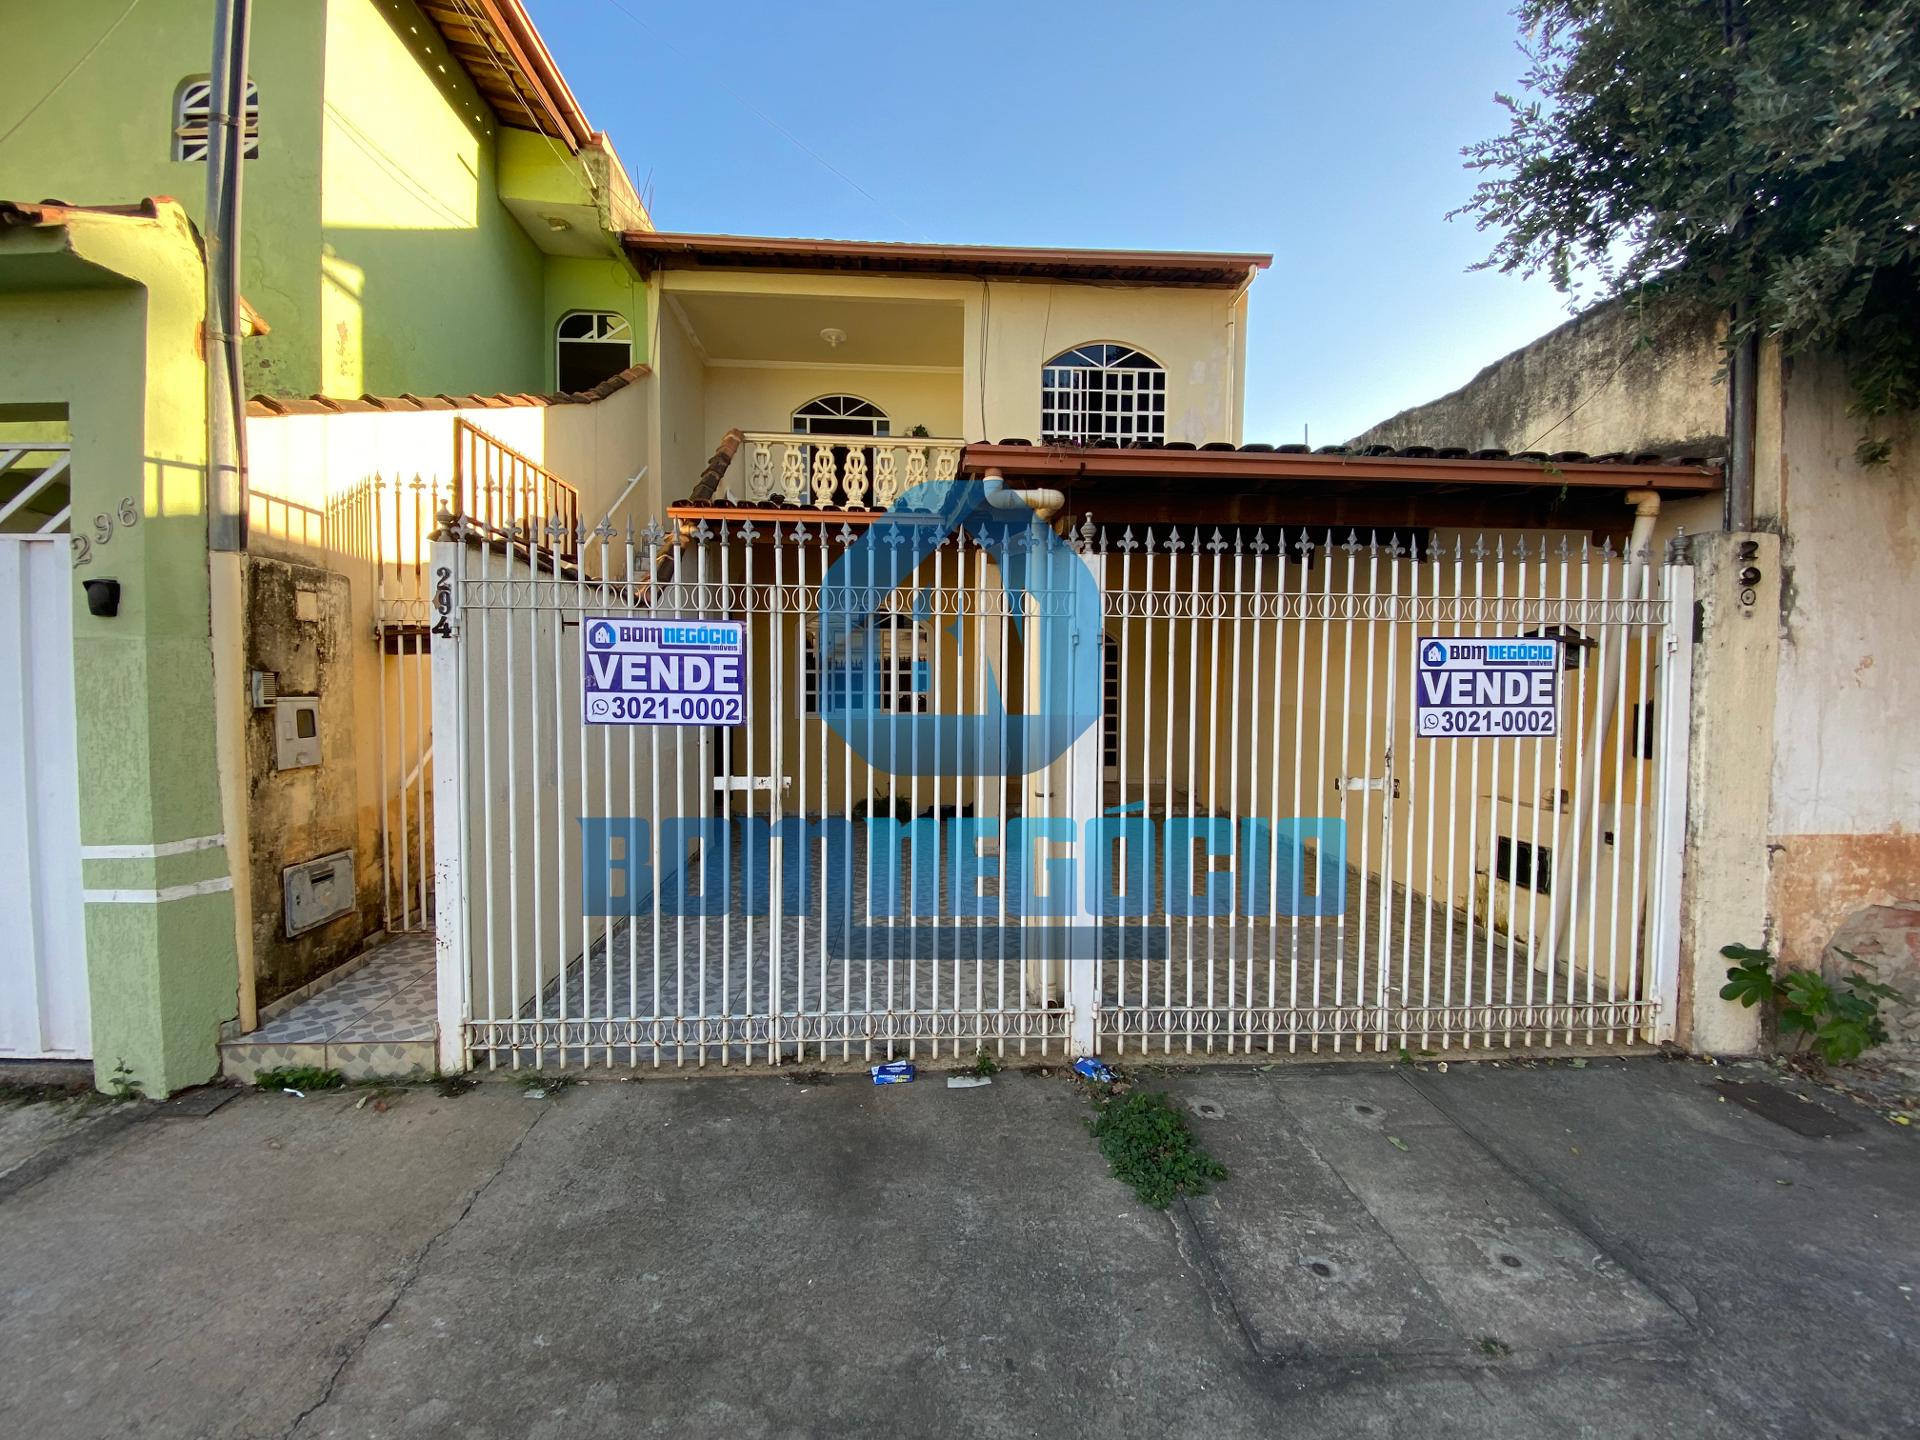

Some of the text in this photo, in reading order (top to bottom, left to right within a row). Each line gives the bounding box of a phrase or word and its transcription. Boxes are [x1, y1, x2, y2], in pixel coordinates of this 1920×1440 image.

[71, 496, 138, 569] 296
[432, 567, 453, 639] 294
[588, 654, 739, 692] VENDE
[1421, 672, 1553, 705] VENDE
[611, 696, 740, 721] 3021-0002
[1441, 710, 1553, 732] 3021-0002
